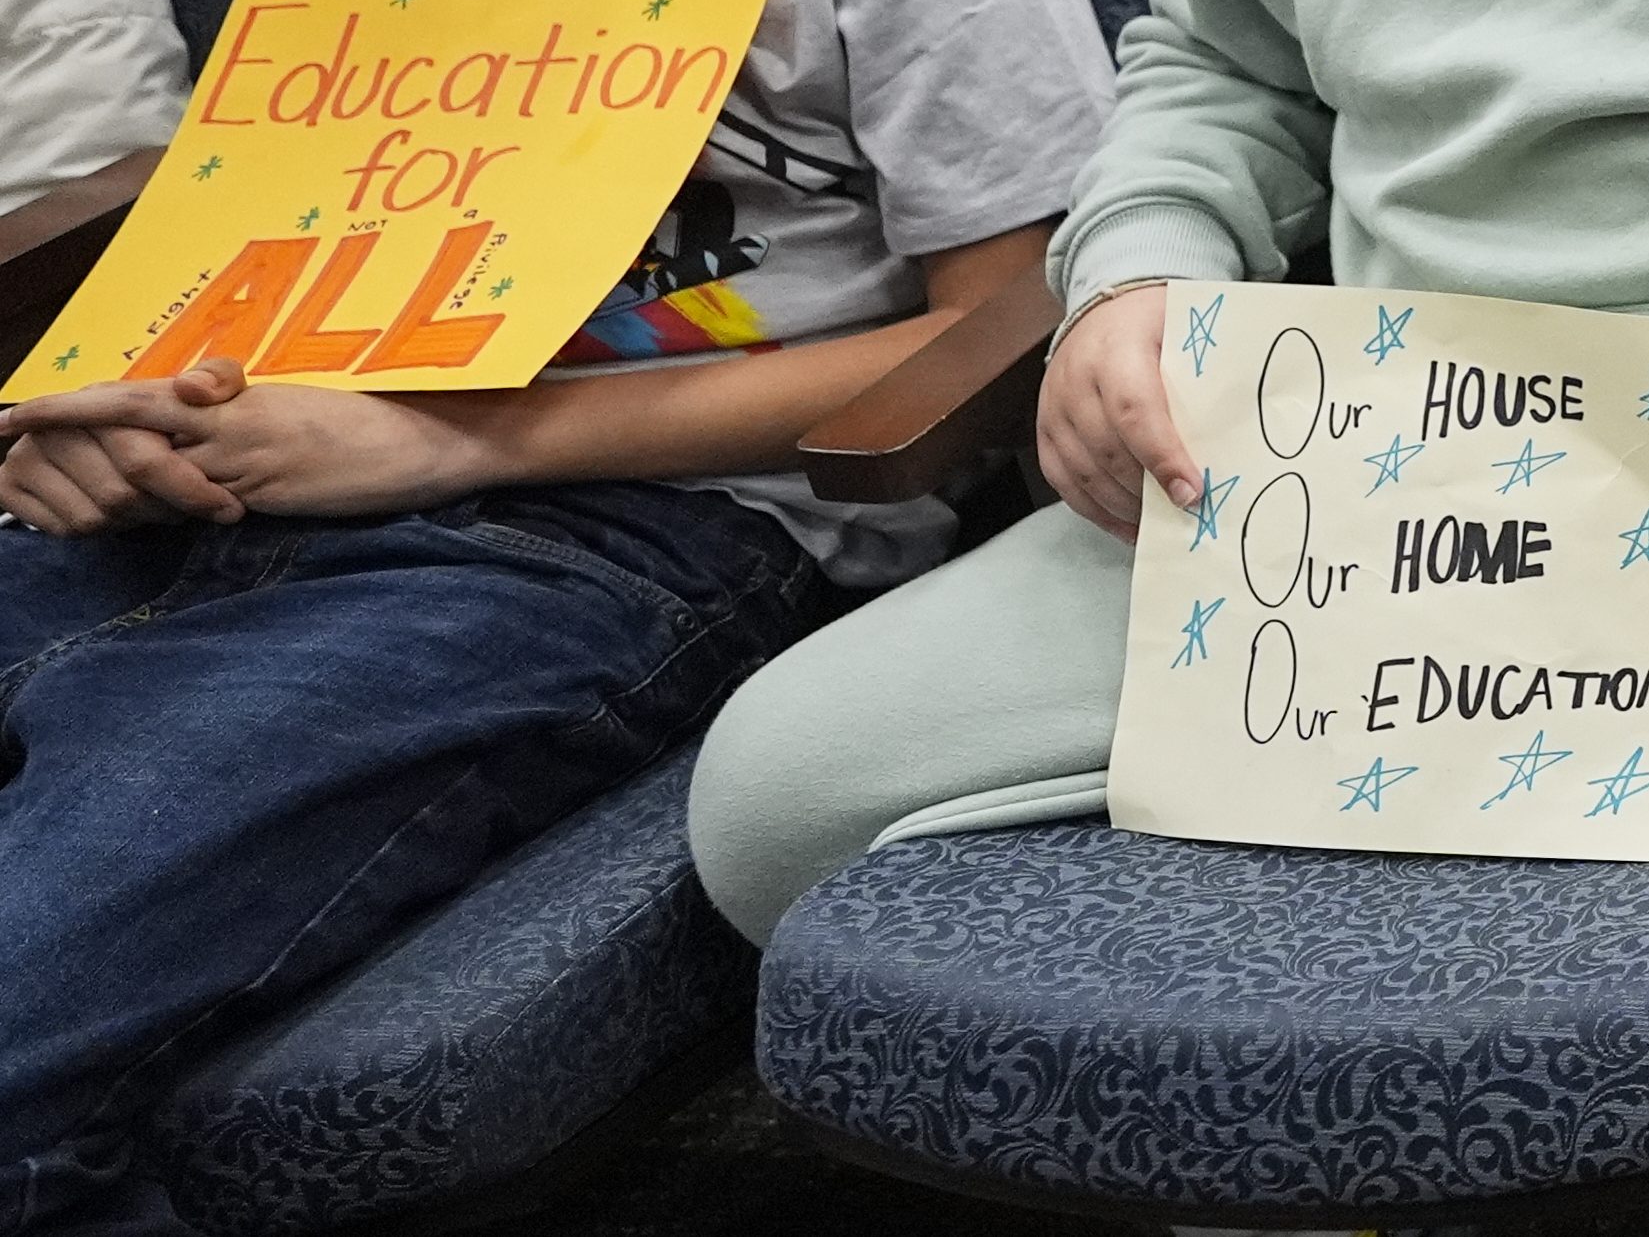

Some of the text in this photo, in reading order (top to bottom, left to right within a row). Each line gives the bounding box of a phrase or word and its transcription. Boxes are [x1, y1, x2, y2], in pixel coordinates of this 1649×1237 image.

[199, 2, 729, 128] Education
[343, 129, 521, 212] for
[348, 219, 388, 232] NOT
[120, 219, 506, 380] ALL
[1257, 327, 1584, 460] Our HOUSE
[1241, 471, 1552, 608] Our HOME
[1243, 618, 1338, 745] Our
